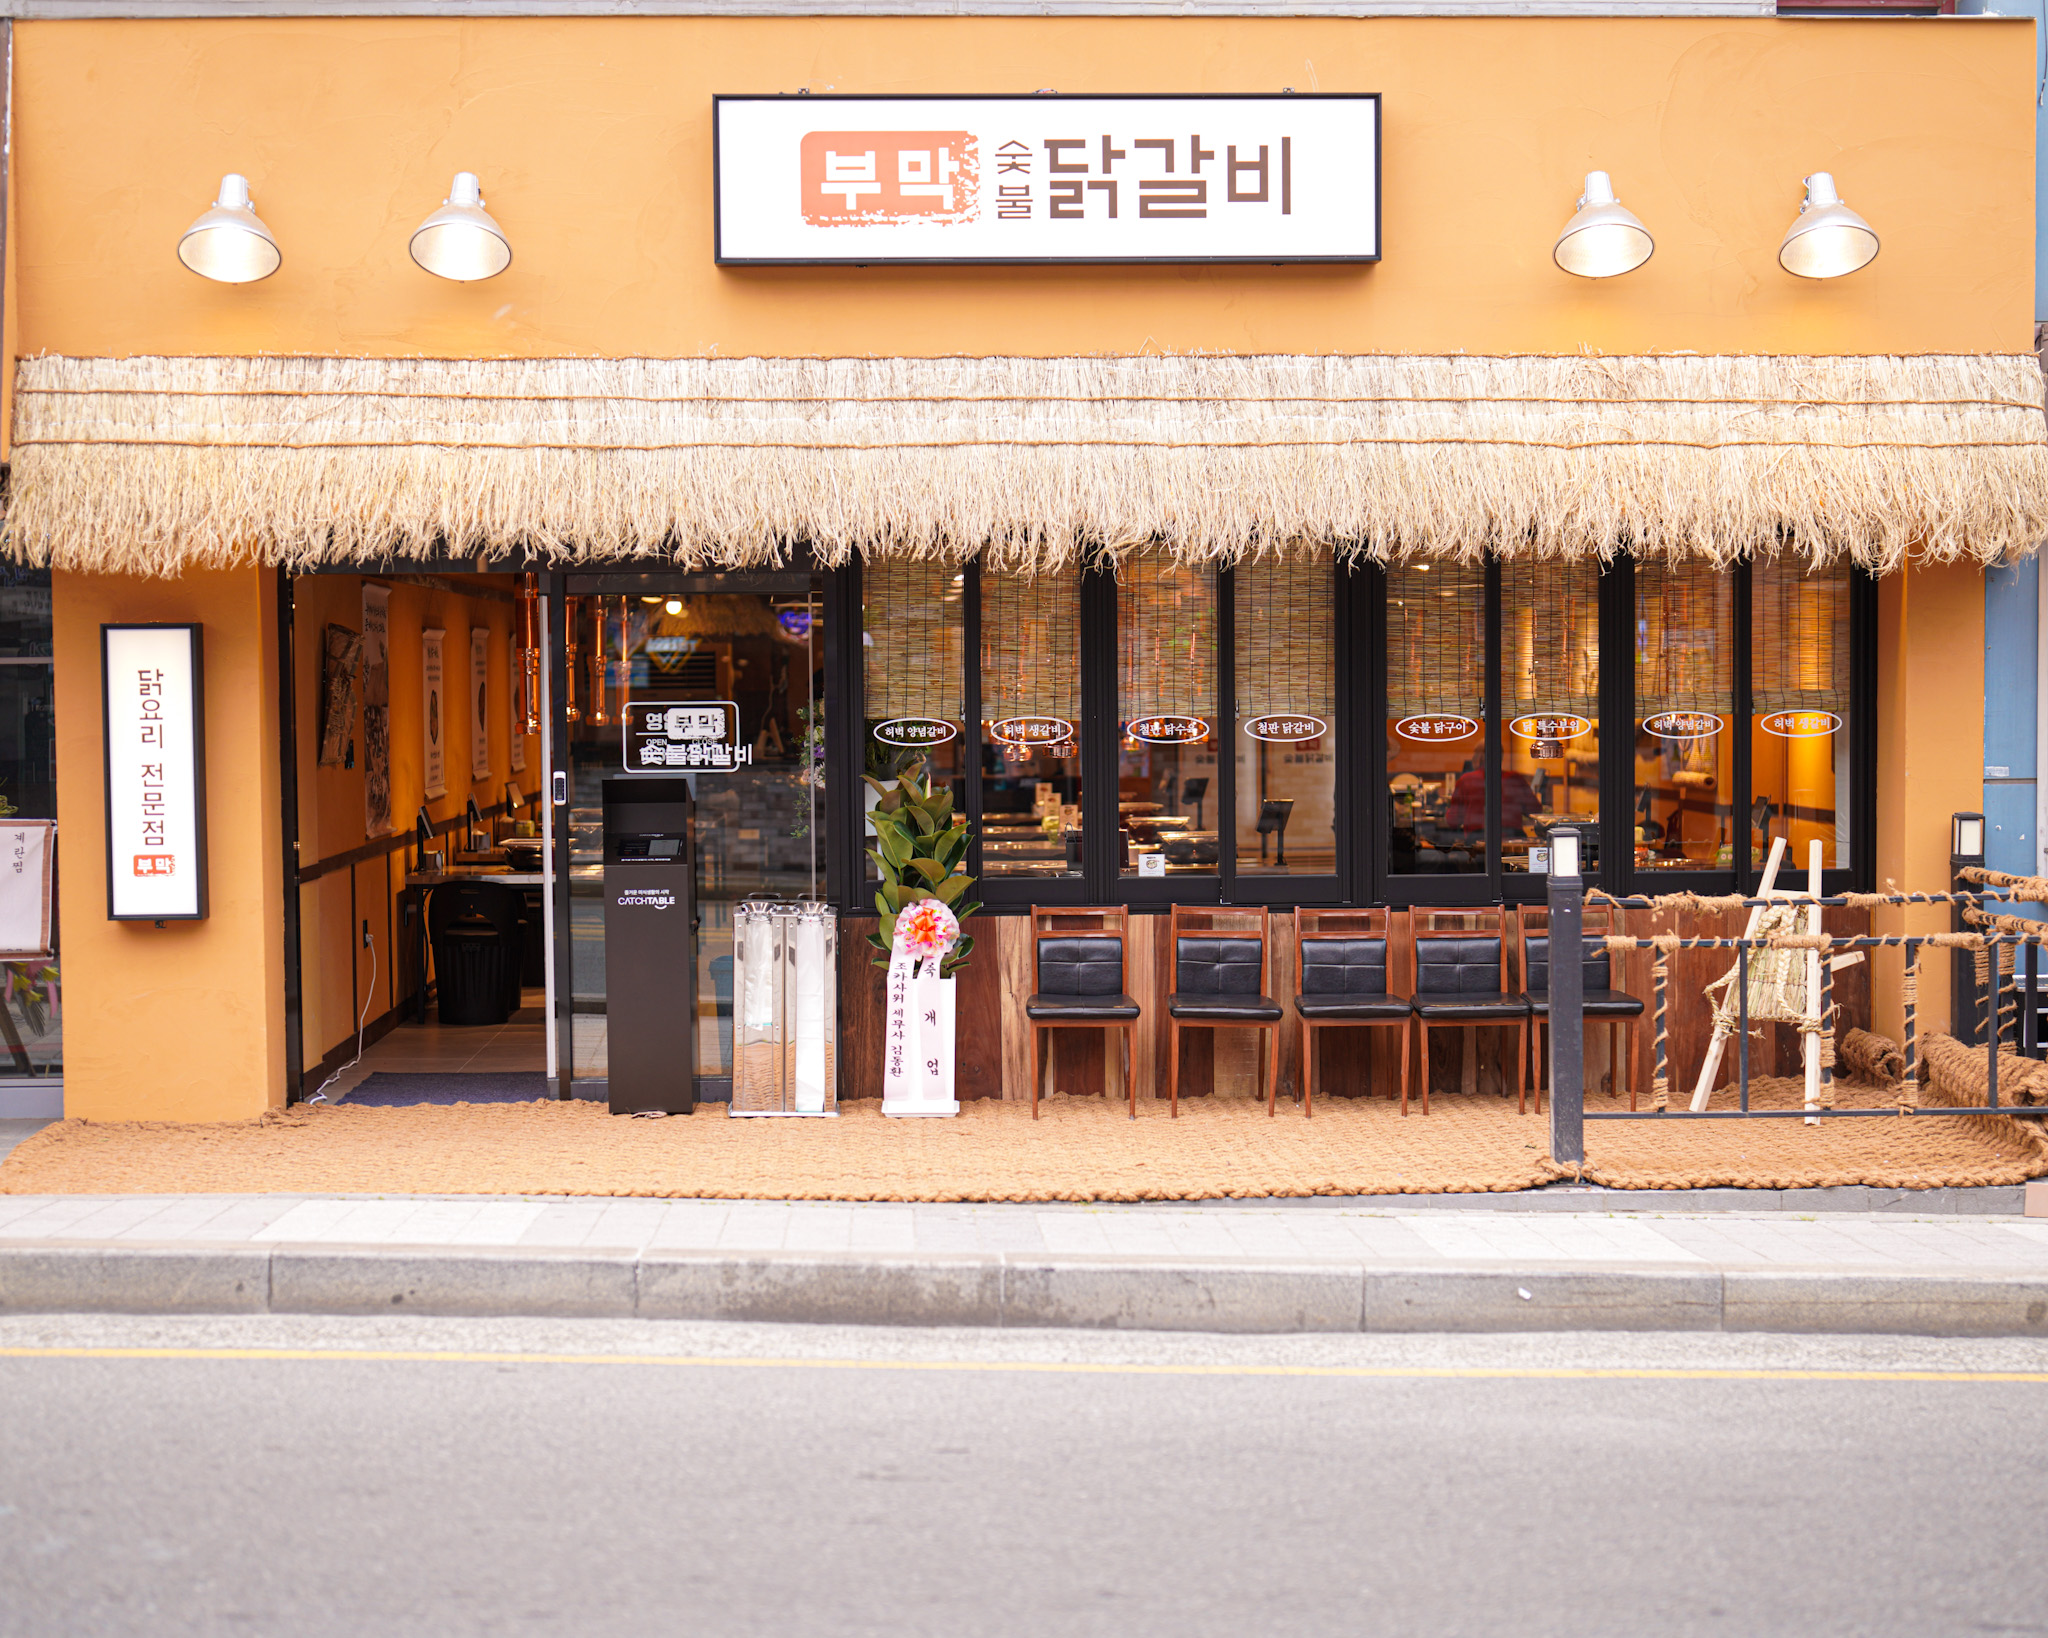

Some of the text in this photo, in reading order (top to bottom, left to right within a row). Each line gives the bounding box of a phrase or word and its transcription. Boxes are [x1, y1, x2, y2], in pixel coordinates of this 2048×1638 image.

[820, 134, 1292, 220] 부막 숯불 닭갈비
[674, 714, 717, 733] 부막
[1004, 723, 1061, 737] 허벅 생갈비
[1139, 722, 1197, 736] 철판 닭수육
[1257, 721, 1315, 735] 철판 닭갈비
[1408, 721, 1467, 735] 숯불 닭구이
[1522, 720, 1580, 733] 닭 특수부위
[1653, 718, 1714, 731] 허벅 양념갈비
[1773, 716, 1831, 730] 허벅 생갈비
[884, 725, 947, 738] 허벅 양념갈비
[645, 738, 718, 746] OPEN CLOSE
[137, 668, 165, 846] 닭요리 전문점
[136, 857, 170, 875] 부막
[617, 897, 675, 905] CATCHTABLE
[888, 962, 908, 1078] 조카사위 세무사 김동환
